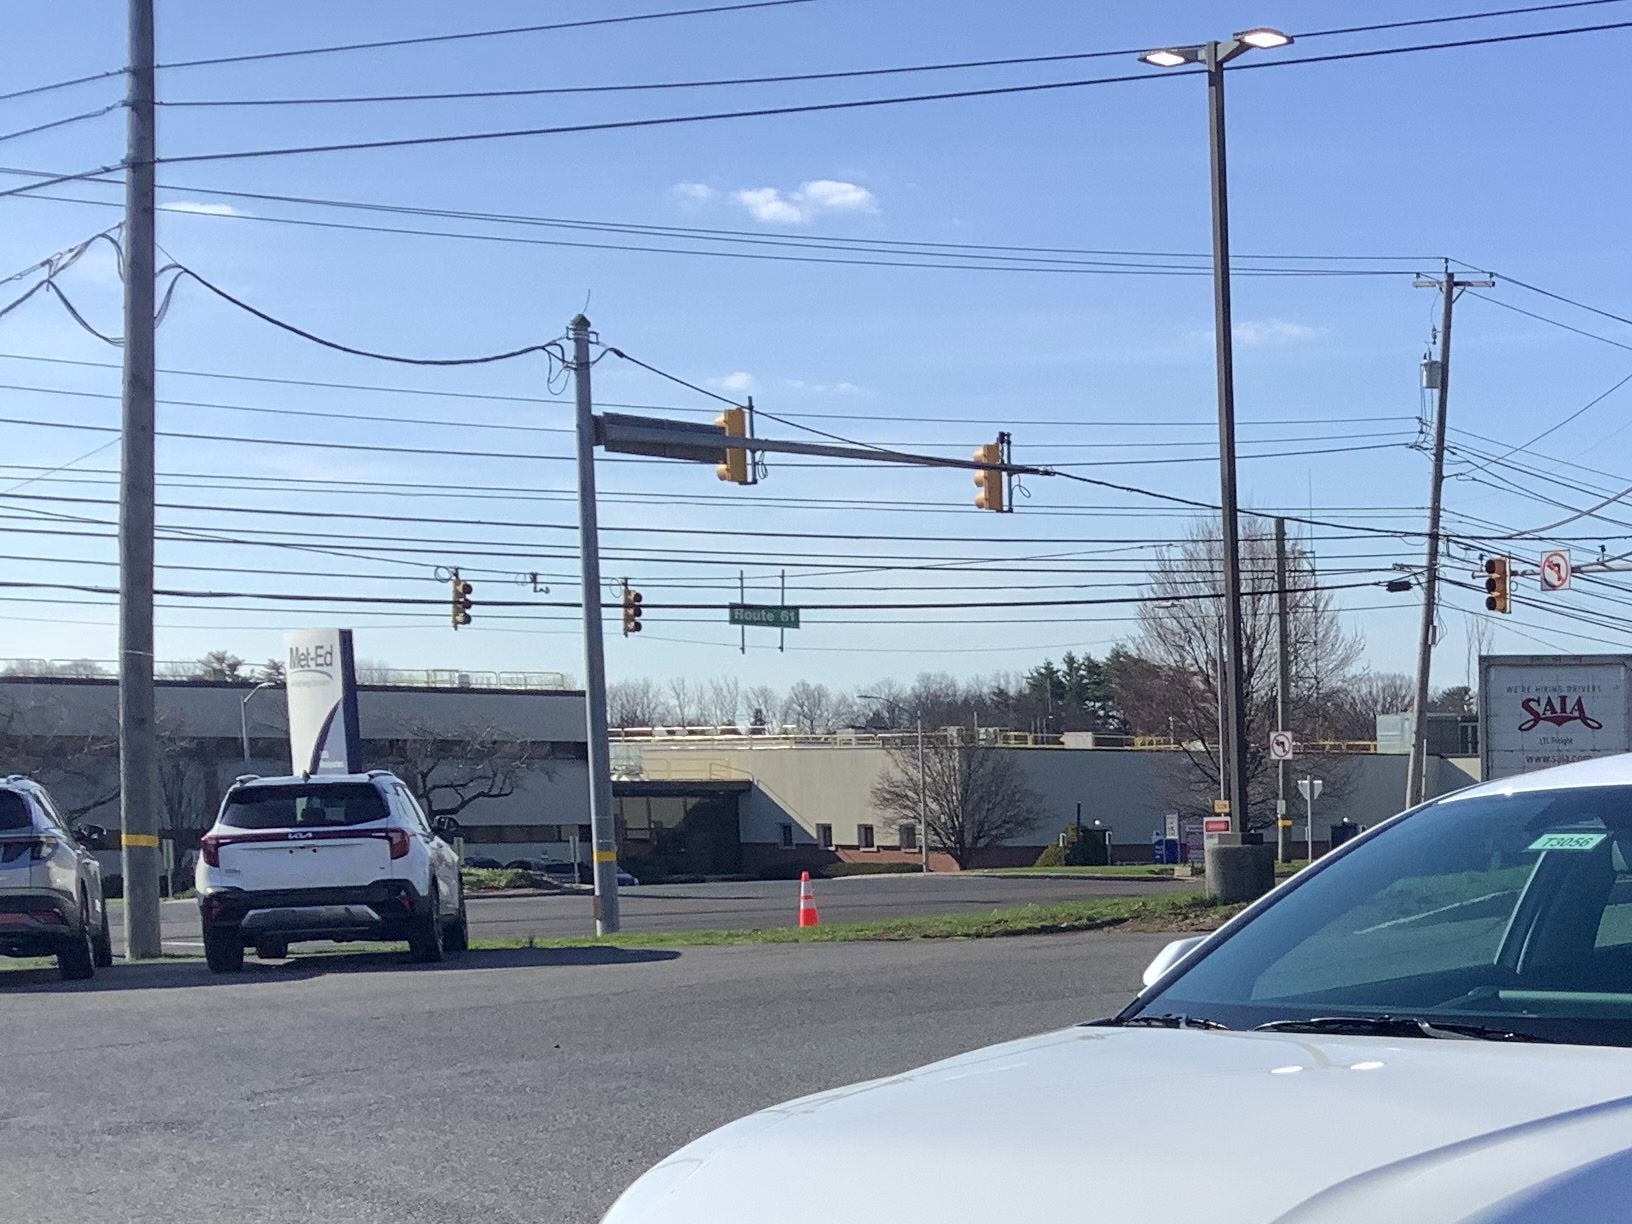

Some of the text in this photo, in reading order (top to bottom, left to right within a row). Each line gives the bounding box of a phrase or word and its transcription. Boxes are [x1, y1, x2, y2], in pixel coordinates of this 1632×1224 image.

[734, 608, 795, 622] Route 61
[289, 644, 333, 669] Met-Ed
[1536, 685, 1563, 693] HIRING
[1566, 684, 1602, 693] DRIVERS
[1518, 695, 1603, 731] SAIA
[1542, 837, 1594, 847] T3056
